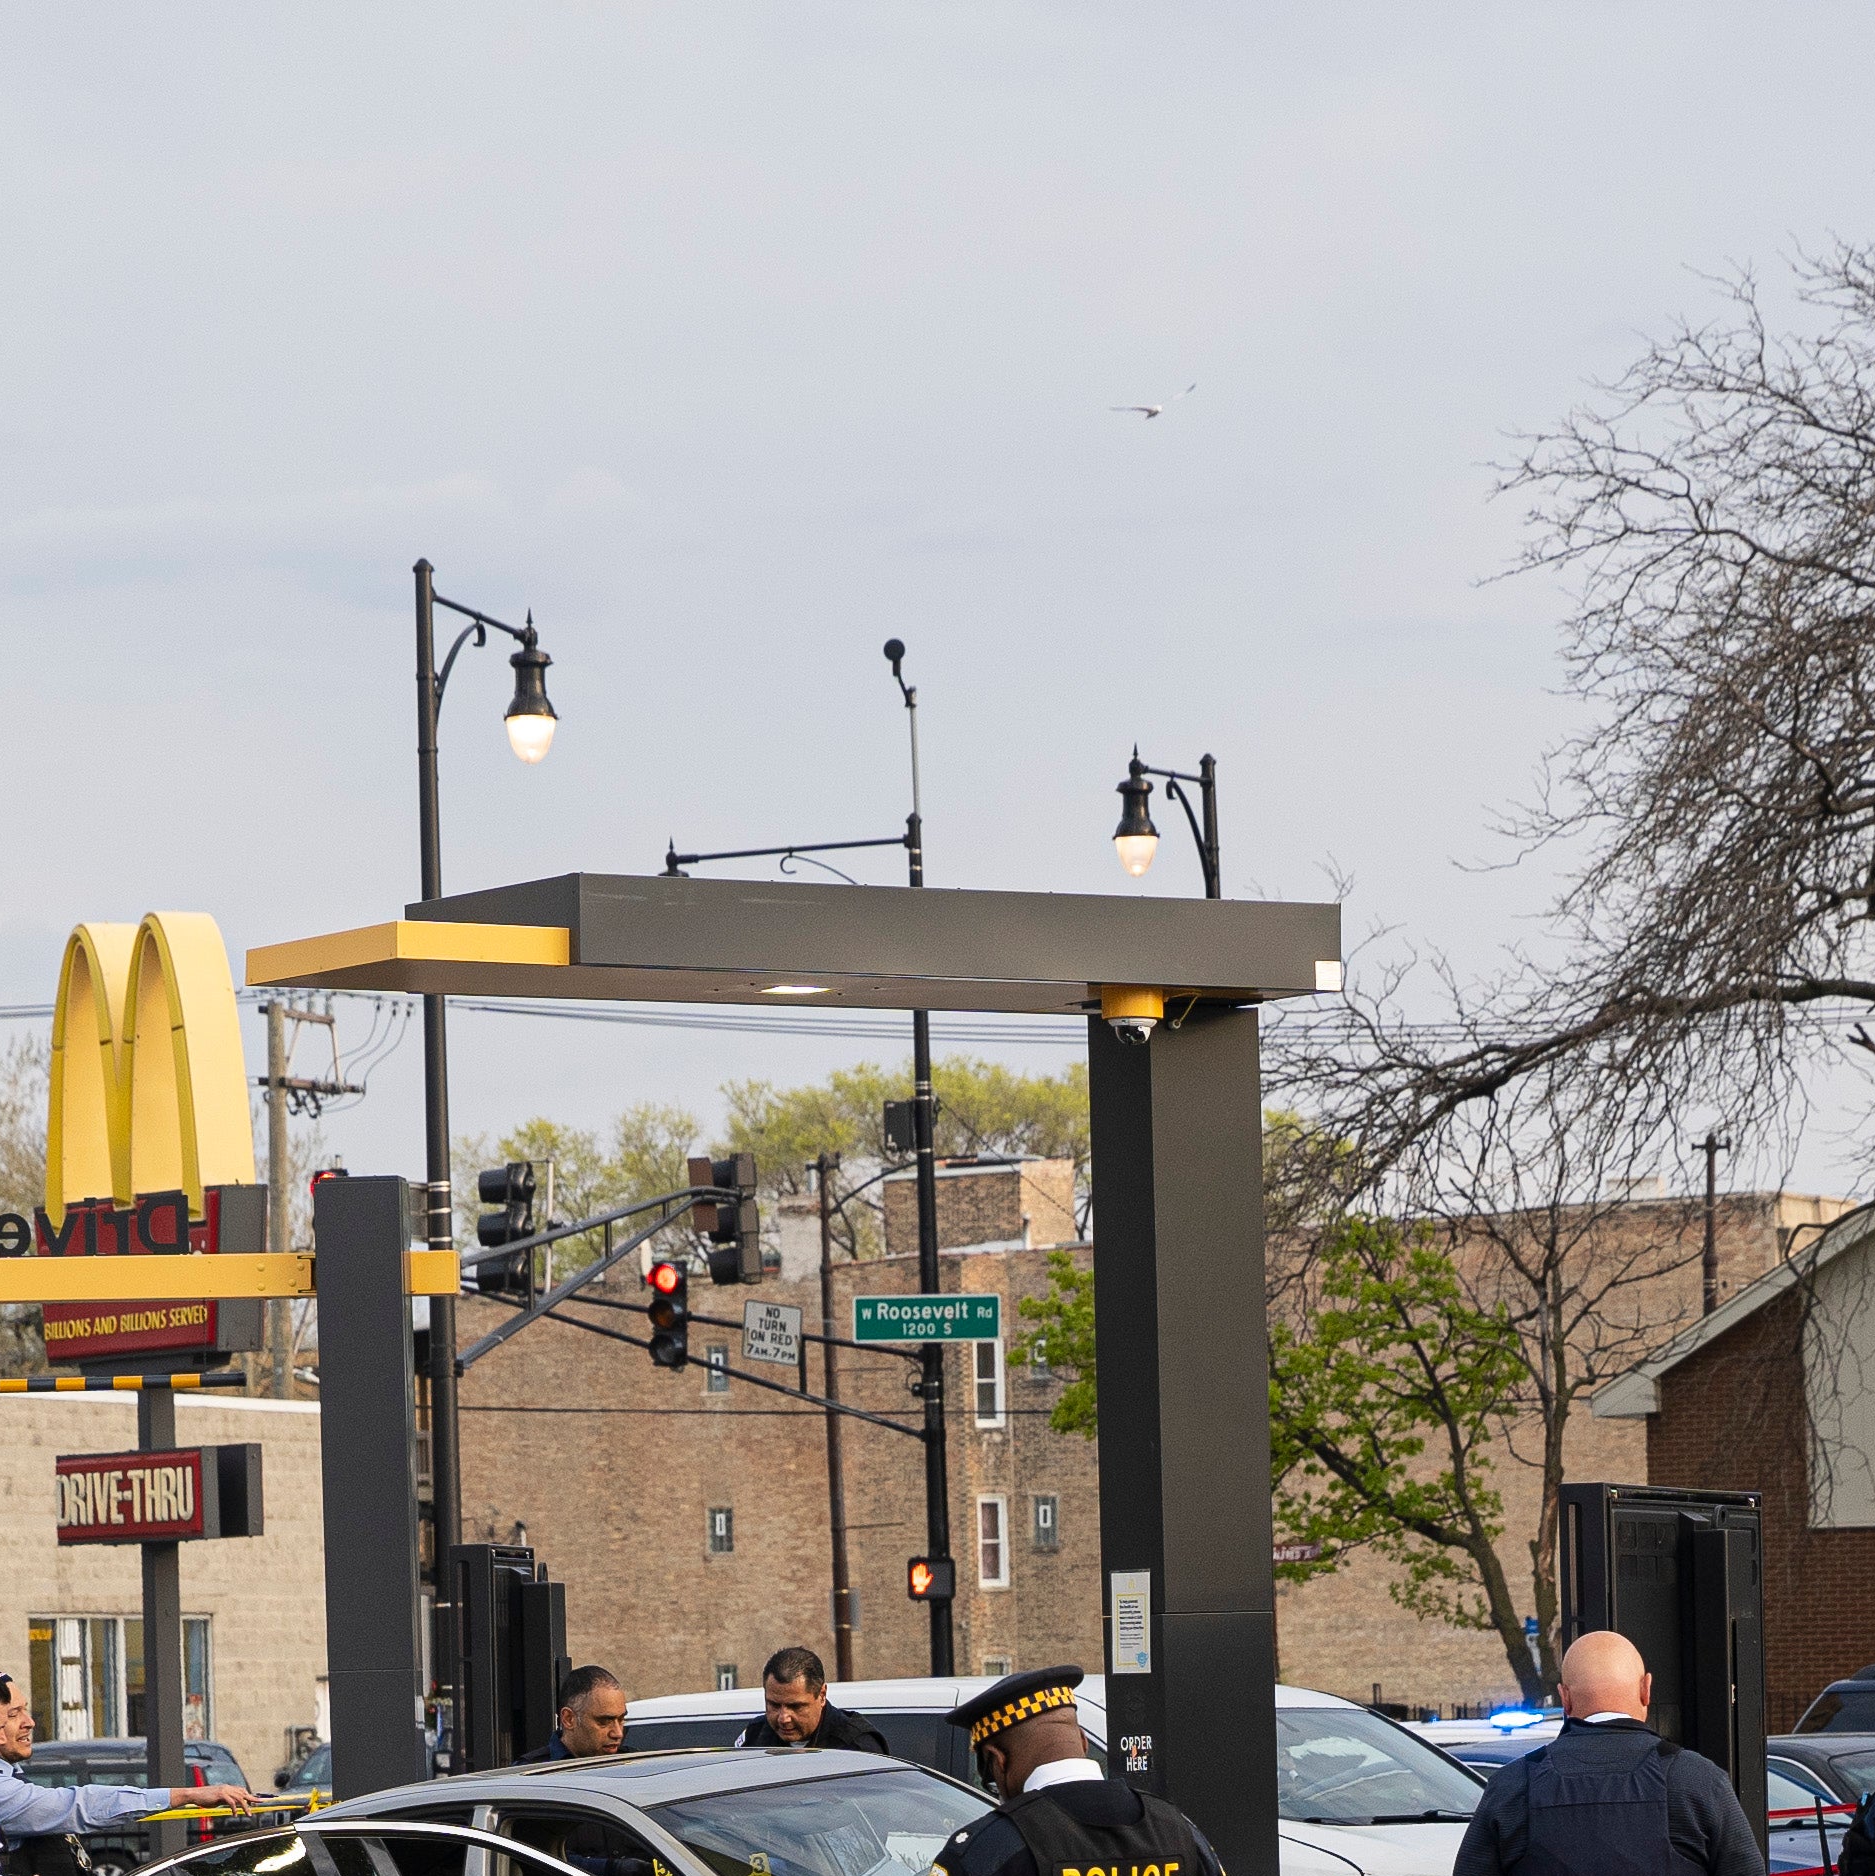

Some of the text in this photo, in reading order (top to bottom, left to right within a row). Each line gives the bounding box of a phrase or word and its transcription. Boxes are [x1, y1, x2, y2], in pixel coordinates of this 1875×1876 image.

[766, 1307, 780, 1319] NO
[862, 1302, 993, 1320] W Roosevelt Rd
[44, 1304, 207, 1340] BILLIONS AND BILLIONS SERVED
[758, 1318, 786, 1332] TURN
[902, 1323, 952, 1336] 1200 S
[750, 1329, 793, 1346] ON RED
[56, 1466, 194, 1528] DRIVE-THRU
[1120, 1735, 1152, 1750] ORDER
[1126, 1756, 1148, 1771] HERE
